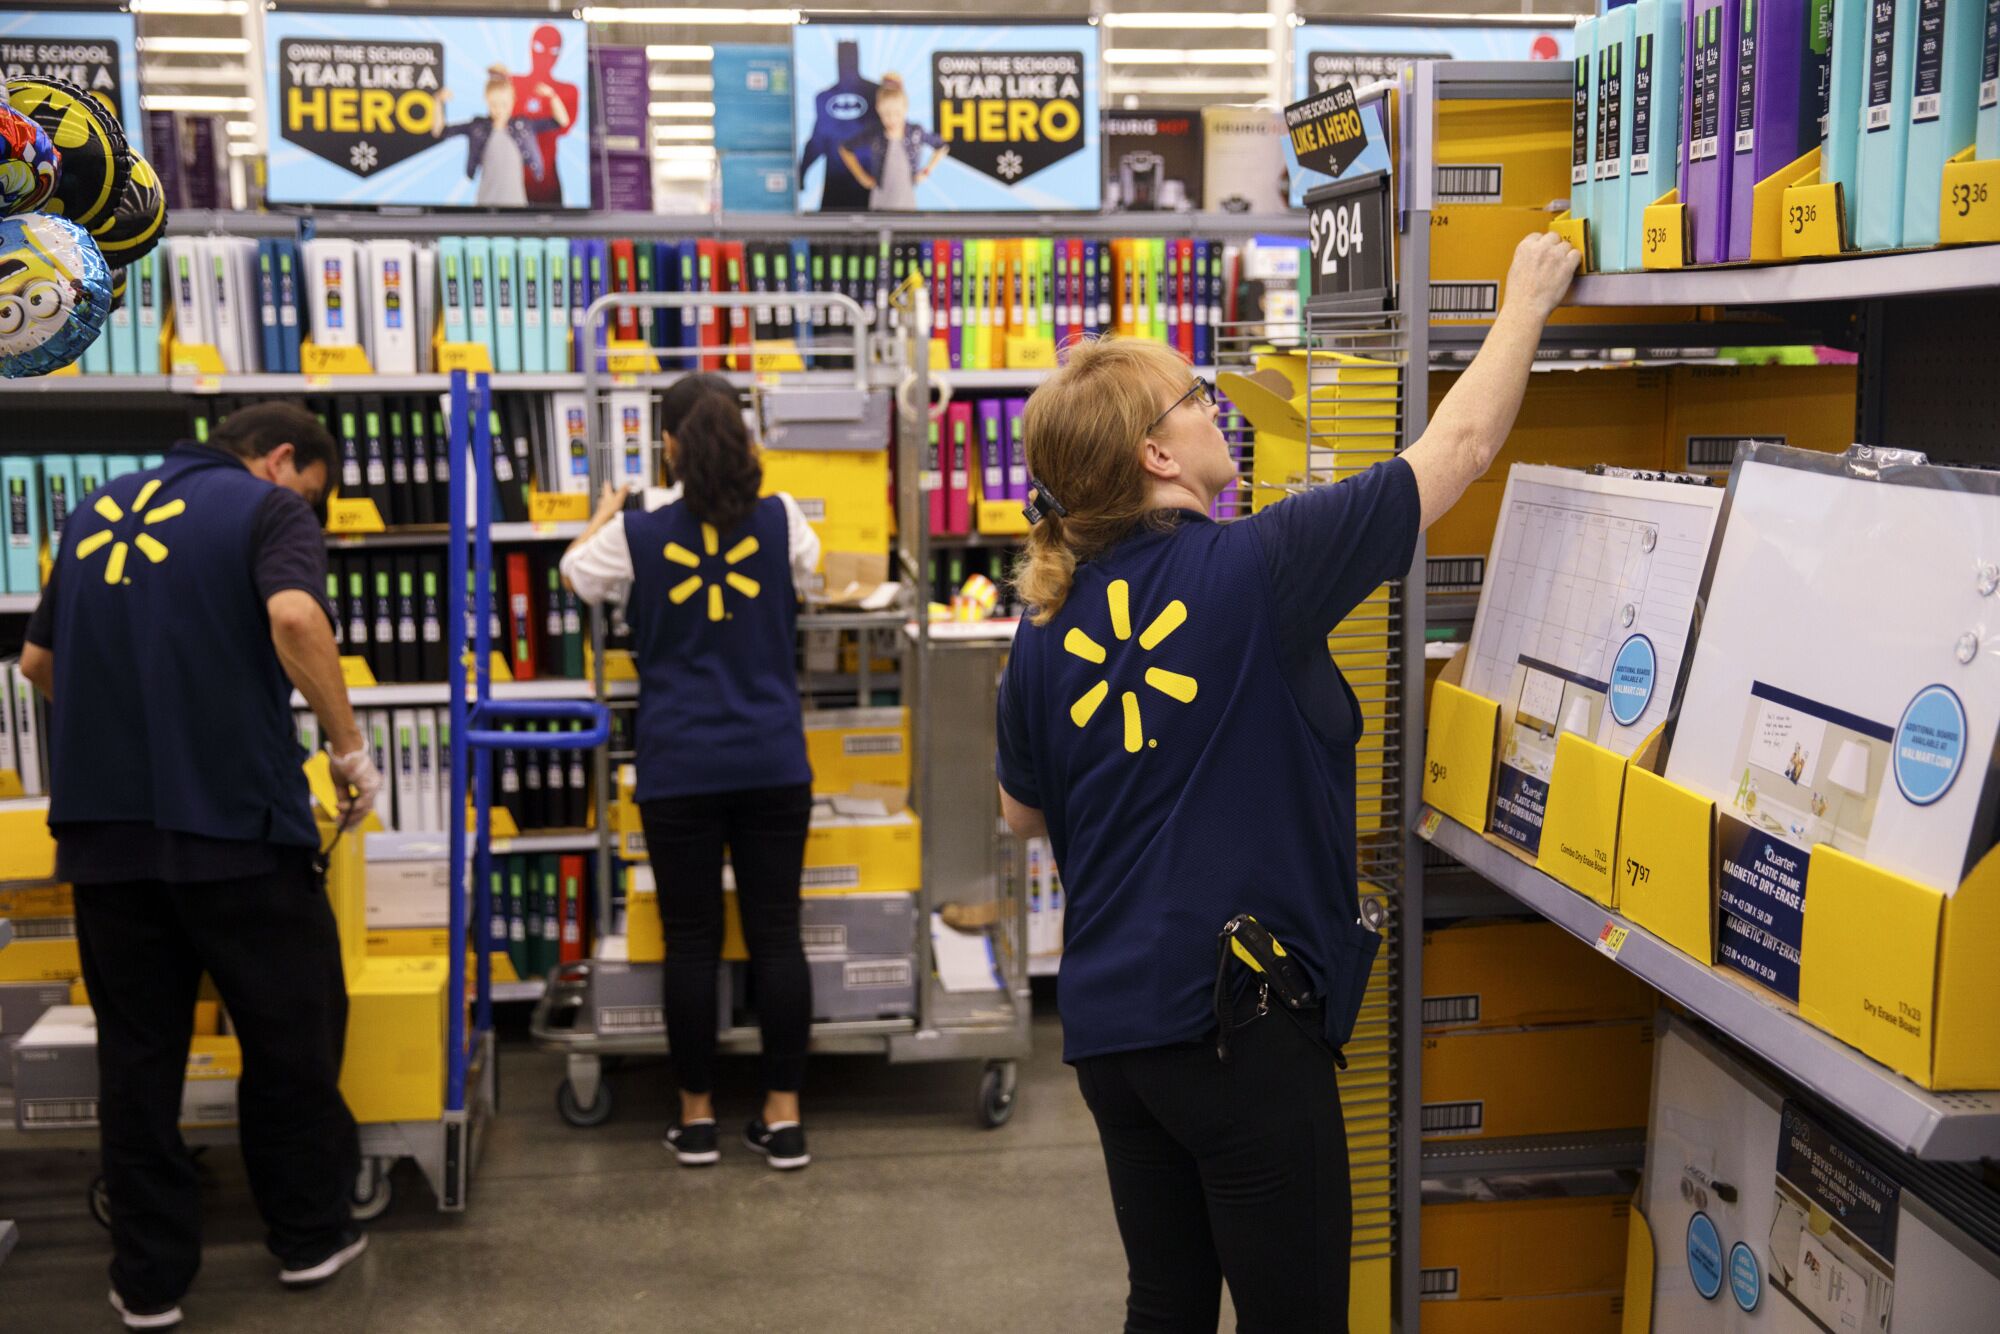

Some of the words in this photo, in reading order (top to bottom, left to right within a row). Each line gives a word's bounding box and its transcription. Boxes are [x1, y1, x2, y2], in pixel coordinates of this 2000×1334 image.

[1, 44, 35, 62] THE
[37, 45, 113, 64] SCHOOL
[287, 43, 332, 61] OWN
[333, 45, 365, 63] THE
[366, 46, 438, 65] SCHOOL
[1923, 42, 1936, 51] 375
[91, 65, 115, 90] A
[287, 62, 356, 87] YEAR
[360, 64, 414, 89] LIKE
[416, 66, 438, 90] A
[938, 56, 980, 74] OWN
[981, 57, 1011, 74] THE
[1012, 57, 1079, 74] SCHOOL
[1314, 56, 1353, 74] OWN
[1355, 57, 1383, 74] THE
[938, 75, 1003, 99] YEAR
[1006, 75, 1057, 99] LIKE
[1058, 75, 1080, 98] A
[287, 87, 437, 135] HERO
[939, 98, 1081, 142] HERO
[1286, 107, 1302, 126] OWN
[1300, 103, 1313, 121] THE
[1311, 96, 1338, 117] SCHOOL
[1336, 89, 1355, 108] YEAR
[1291, 123, 1318, 155] LIKE
[1316, 121, 1329, 148] A
[1324, 109, 1362, 146] HERO
[1560, 843, 1576, 858] Combo
[1583, 854, 1595, 870] Erase
[1594, 862, 1607, 875] Board
[1766, 848, 1795, 872] Quartet
[1723, 859, 1759, 887] MAGNETIC
[1758, 878, 1801, 910] DRY-ERASE
[1754, 860, 1779, 881] PLASTIC
[1778, 872, 1801, 892] FRAME
[1721, 891, 1729, 901] 23
[1728, 894, 1734, 904] IN
[1737, 899, 1744, 910] 43
[1744, 902, 1753, 914] CM
[1756, 909, 1764, 921] 58
[1763, 913, 1773, 926] CM
[1726, 915, 1761, 943] MAGNETIC
[1761, 935, 1802, 965] DRY-ERAS
[1725, 946, 1732, 957] 23
[1731, 949, 1738, 960] IN
[1741, 955, 1748, 966] 43
[1747, 958, 1756, 970] CM
[1760, 965, 1768, 977] 58
[1767, 968, 1777, 982] CM
[1864, 998, 1877, 1016] Dry
[1878, 1005, 1897, 1026] Erase
[1899, 1016, 1921, 1037] Board
[1898, 1001, 1921, 1021] 17x23
[1791, 1136, 1812, 1160] BOARD
[1812, 1152, 1847, 1187] DRY-ERASE
[1848, 1180, 1881, 1214] MAGNETIC
